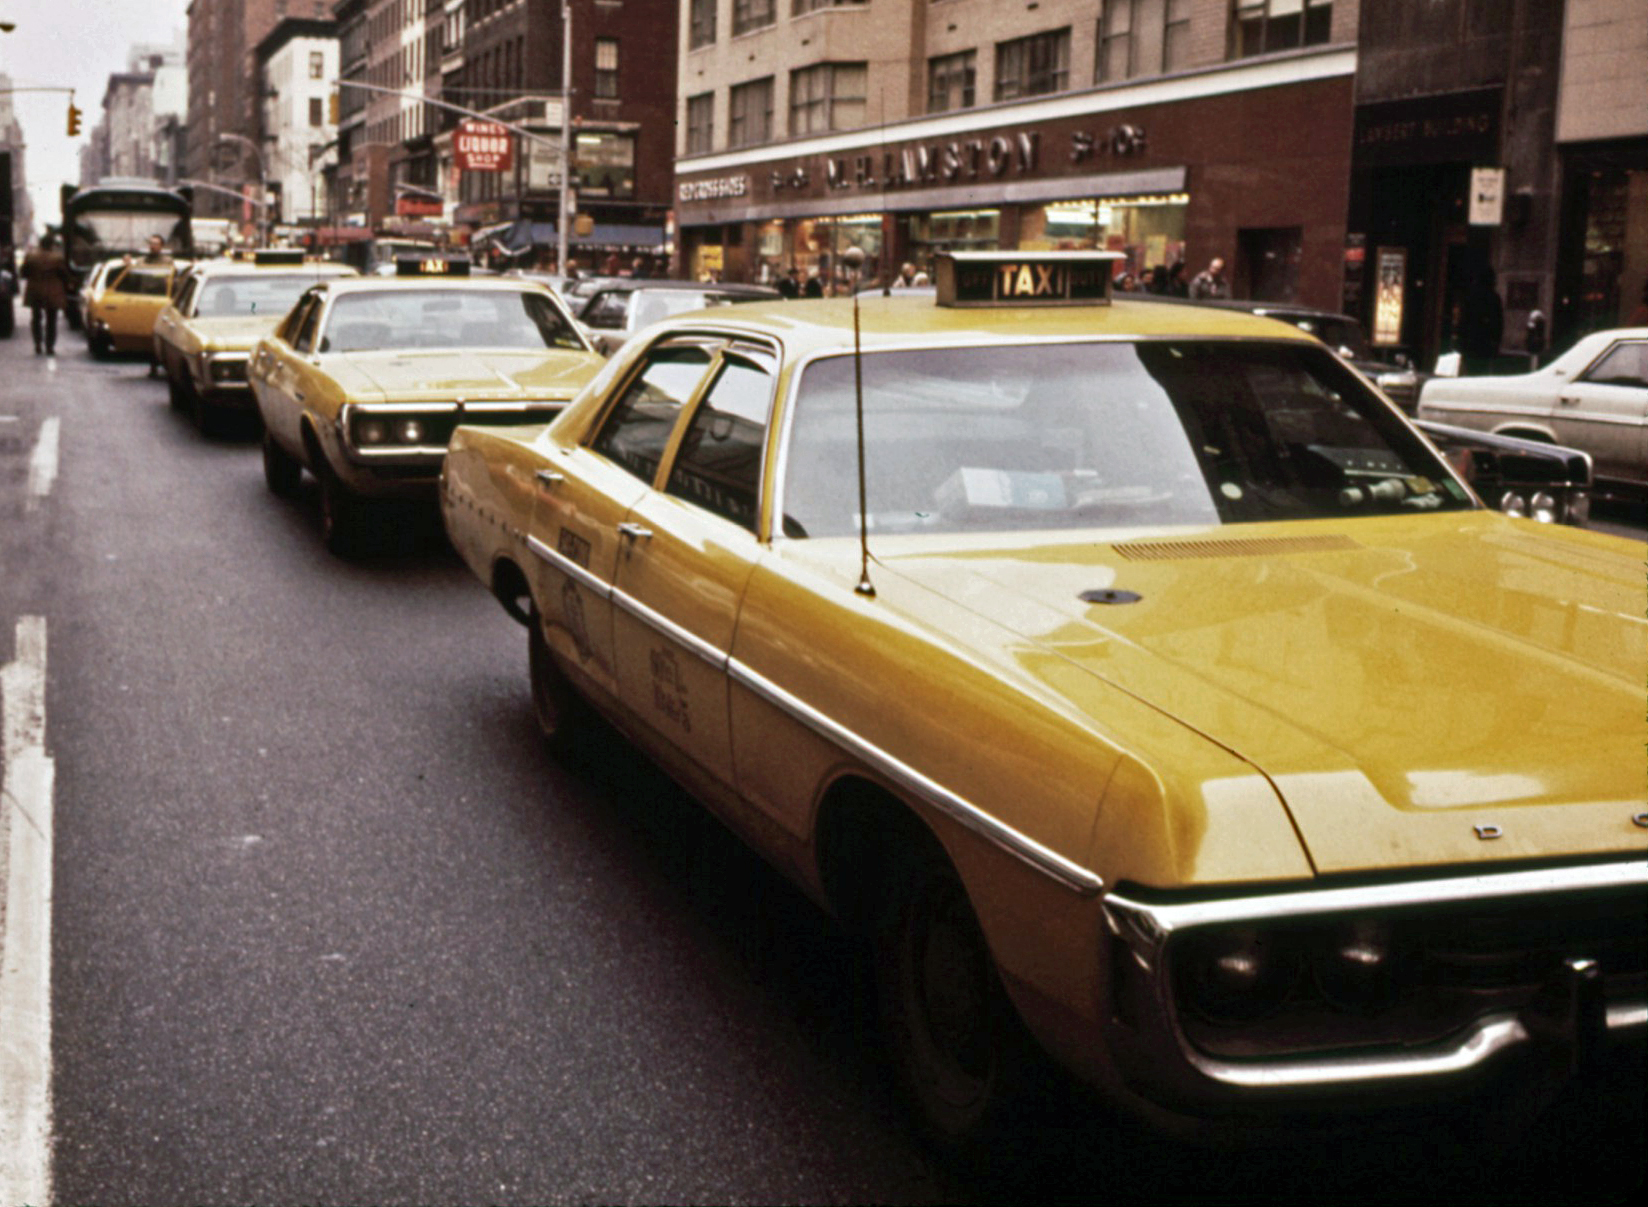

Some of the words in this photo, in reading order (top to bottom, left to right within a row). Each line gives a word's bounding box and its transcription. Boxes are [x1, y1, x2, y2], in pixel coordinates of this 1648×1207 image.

[458, 135, 509, 155] LIQUOR
[466, 153, 501, 164] SHOP
[1000, 264, 1064, 296] TAXI
